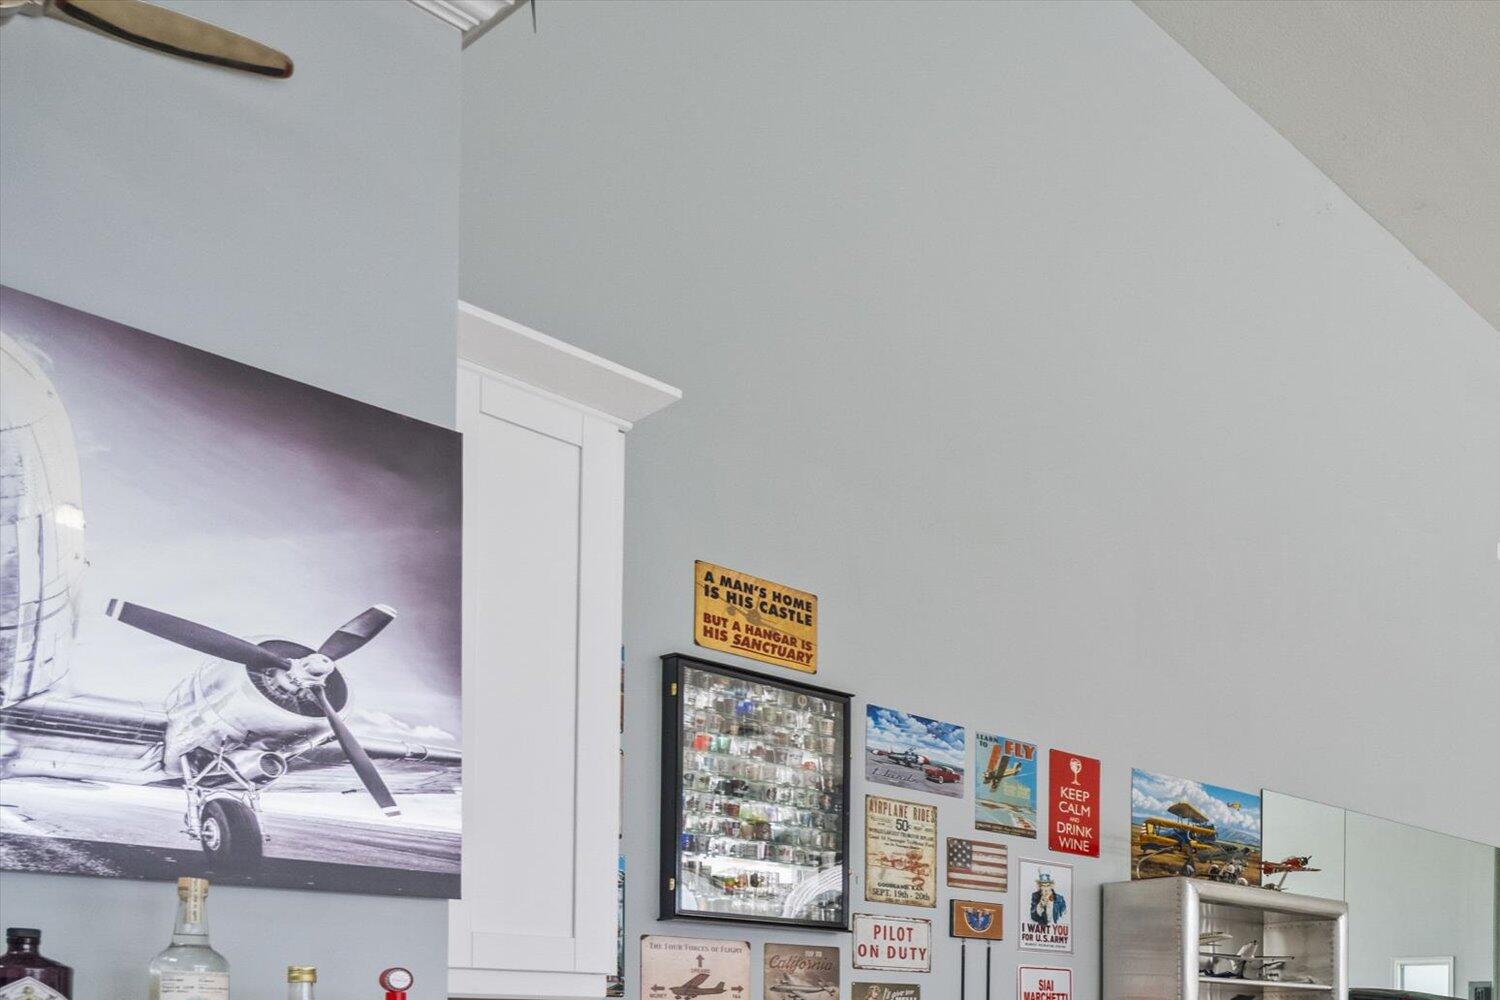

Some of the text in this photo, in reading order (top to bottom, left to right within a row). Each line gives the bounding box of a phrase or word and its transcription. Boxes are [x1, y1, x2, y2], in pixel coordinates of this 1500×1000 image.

[704, 571, 813, 613] A MAN'S HOME
[704, 584, 813, 627] IS HIS CASTLE
[703, 612, 813, 651] BUT A HANGAR IS
[703, 625, 813, 664] HIS SANCTUARY
[976, 733, 999, 743] LEARN
[979, 740, 988, 748] TO
[1004, 740, 1035, 760] FLY
[1060, 786, 1090, 802] KEEP
[869, 798, 908, 819] AIRPLANE
[912, 806, 935, 823] RIDES
[1058, 801, 1091, 818] CALM
[1056, 821, 1093, 839] DRINK
[1058, 836, 1090, 852] WINE
[873, 887, 892, 897] SEPT.
[873, 924, 914, 942] PILOT
[1022, 922, 1069, 936] I WANT YOU
[1022, 933, 1033, 941] FOR
[684, 944, 709, 952] FORCES
[720, 945, 742, 954] FLIGHT
[858, 944, 927, 960] ON DUTY
[769, 954, 834, 974] California
[1038, 979, 1054, 991] SIAI
